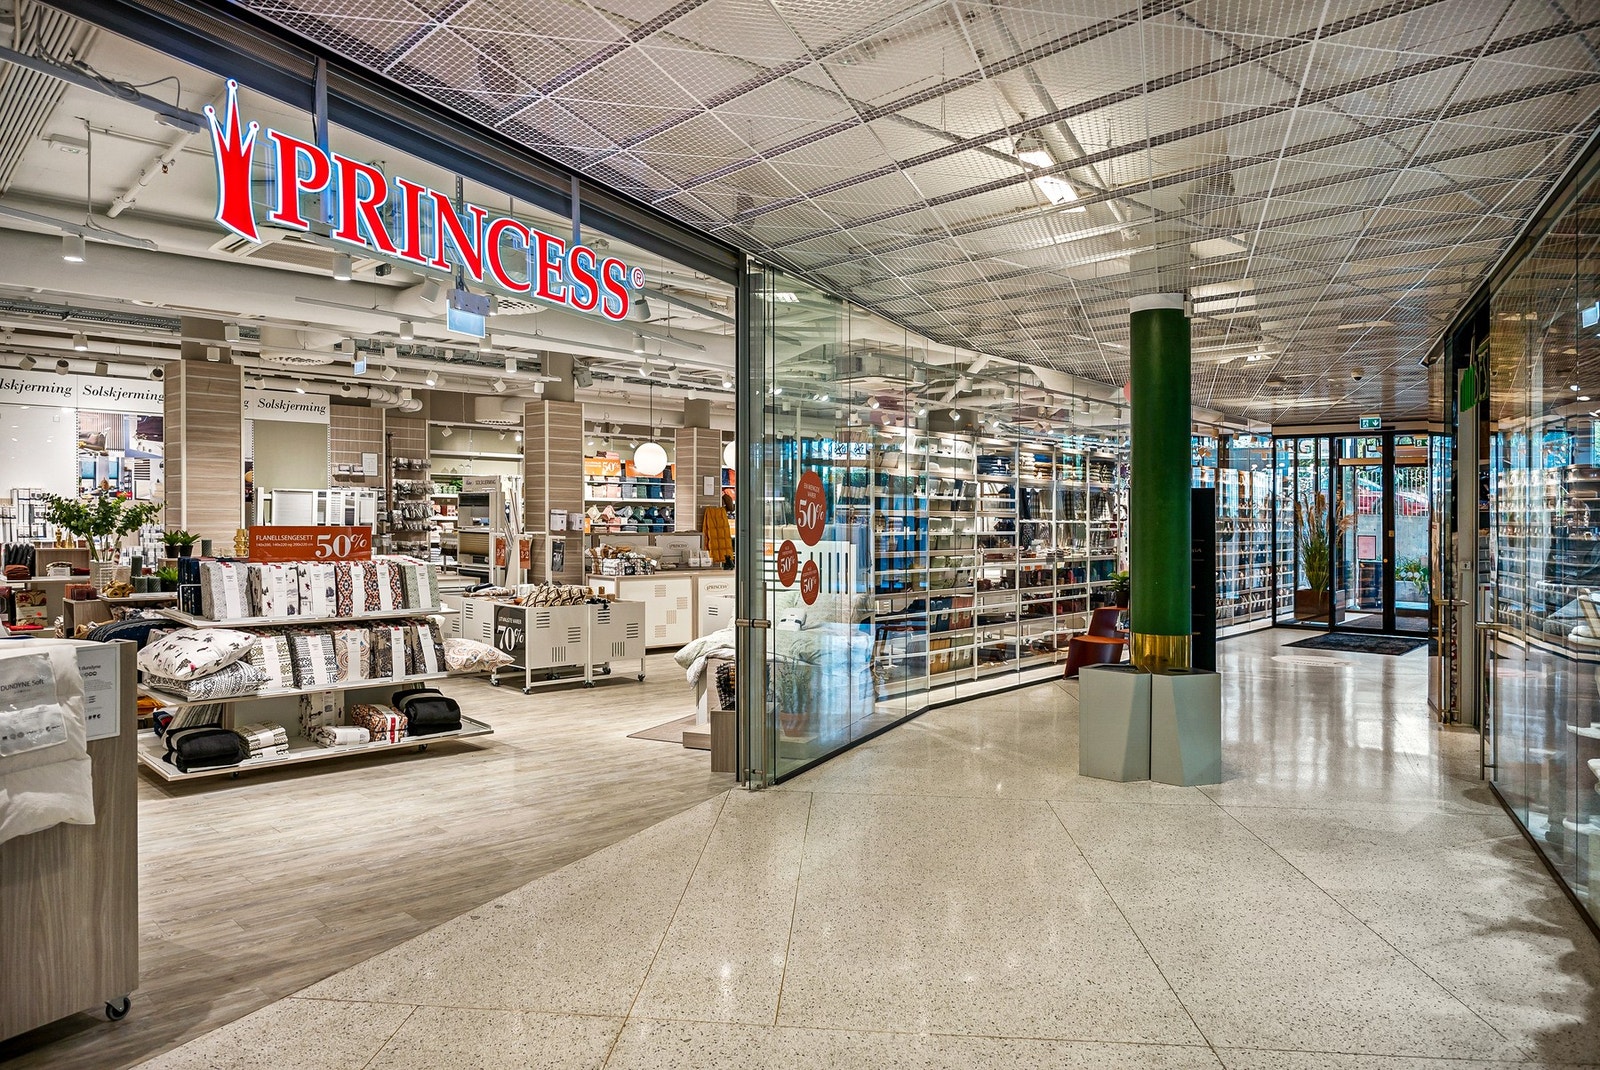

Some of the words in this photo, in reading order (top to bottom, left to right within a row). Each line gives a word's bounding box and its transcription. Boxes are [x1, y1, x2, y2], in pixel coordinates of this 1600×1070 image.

[82, 384, 164, 404] Solskjerming
[257, 397, 326, 415] Solskjerming
[798, 499, 824, 530] 50%
[314, 533, 368, 558] 50%
[780, 555, 795, 573] 50%
[803, 576, 817, 593] 50%
[496, 625, 525, 651] 70%
[0, 680, 31, 692] DUNDYNE
